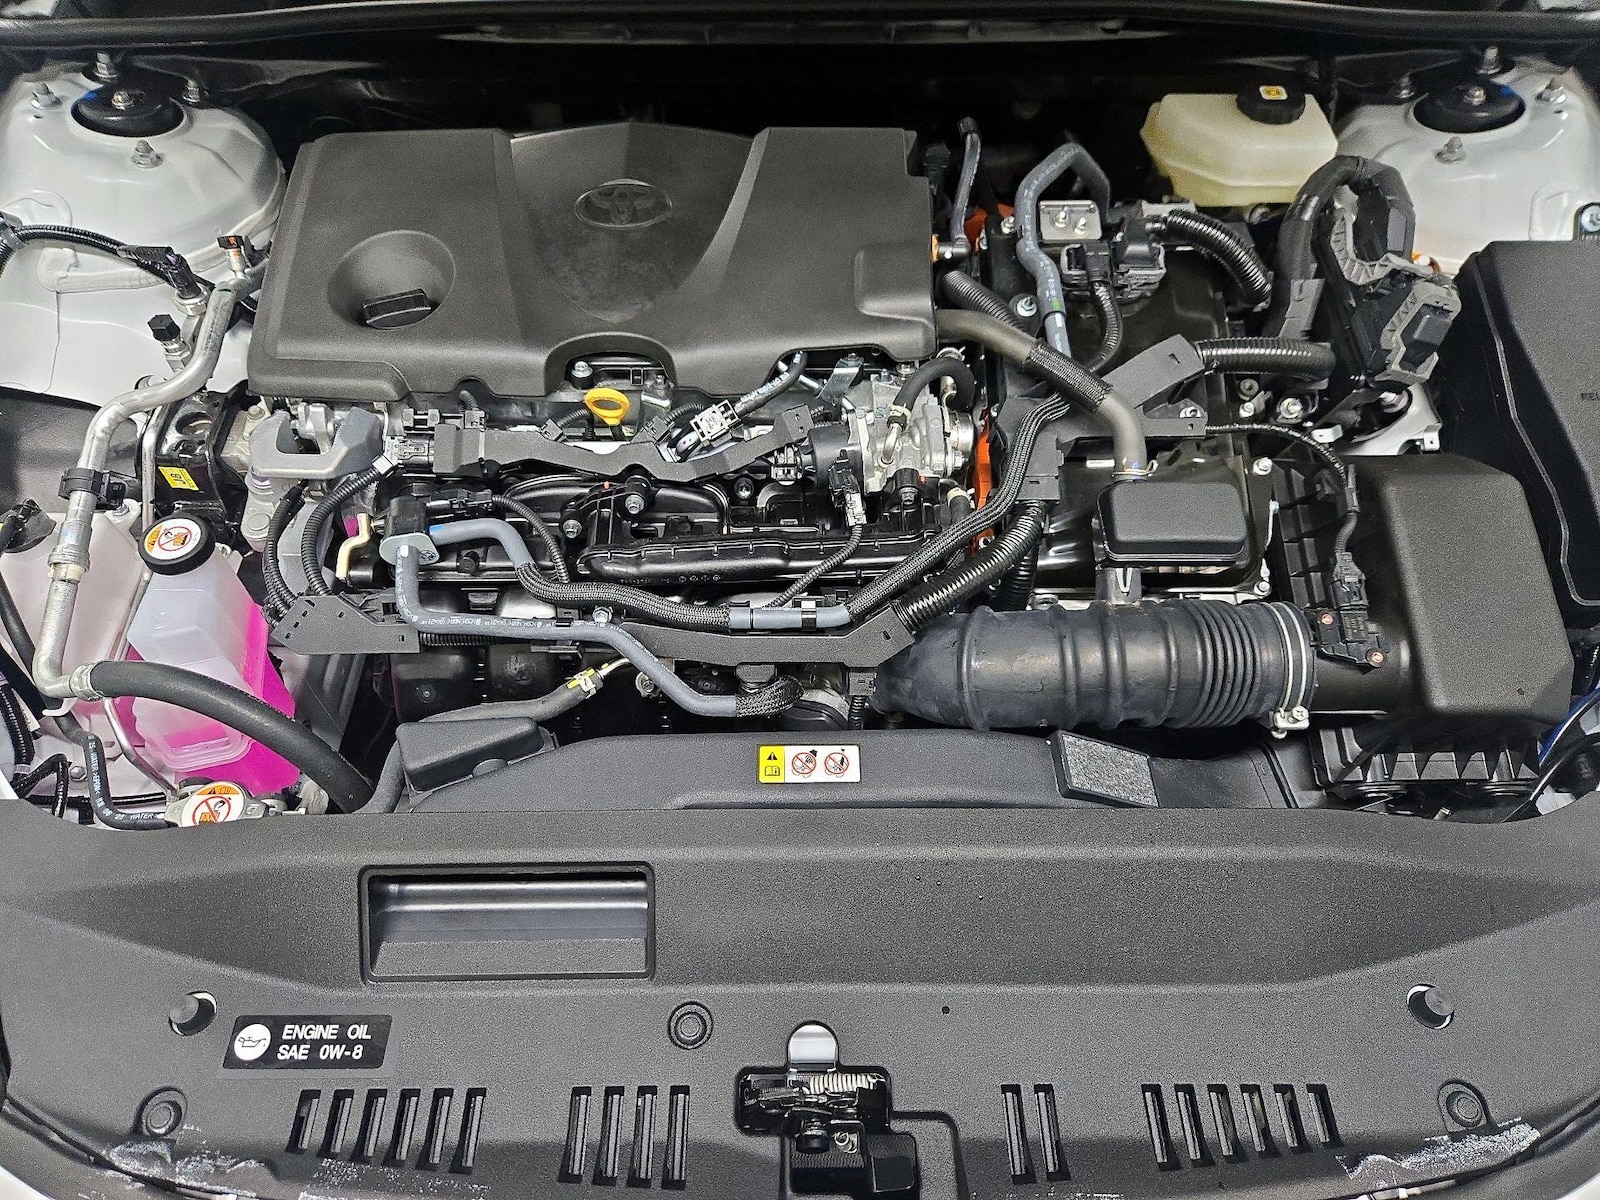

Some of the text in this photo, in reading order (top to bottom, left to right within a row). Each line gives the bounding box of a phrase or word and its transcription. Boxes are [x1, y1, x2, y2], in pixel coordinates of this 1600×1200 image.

[130, 812, 154, 820] WATER
[282, 1024, 372, 1040] ENGINE OIL
[277, 1044, 363, 1060] SAE 0W-8
